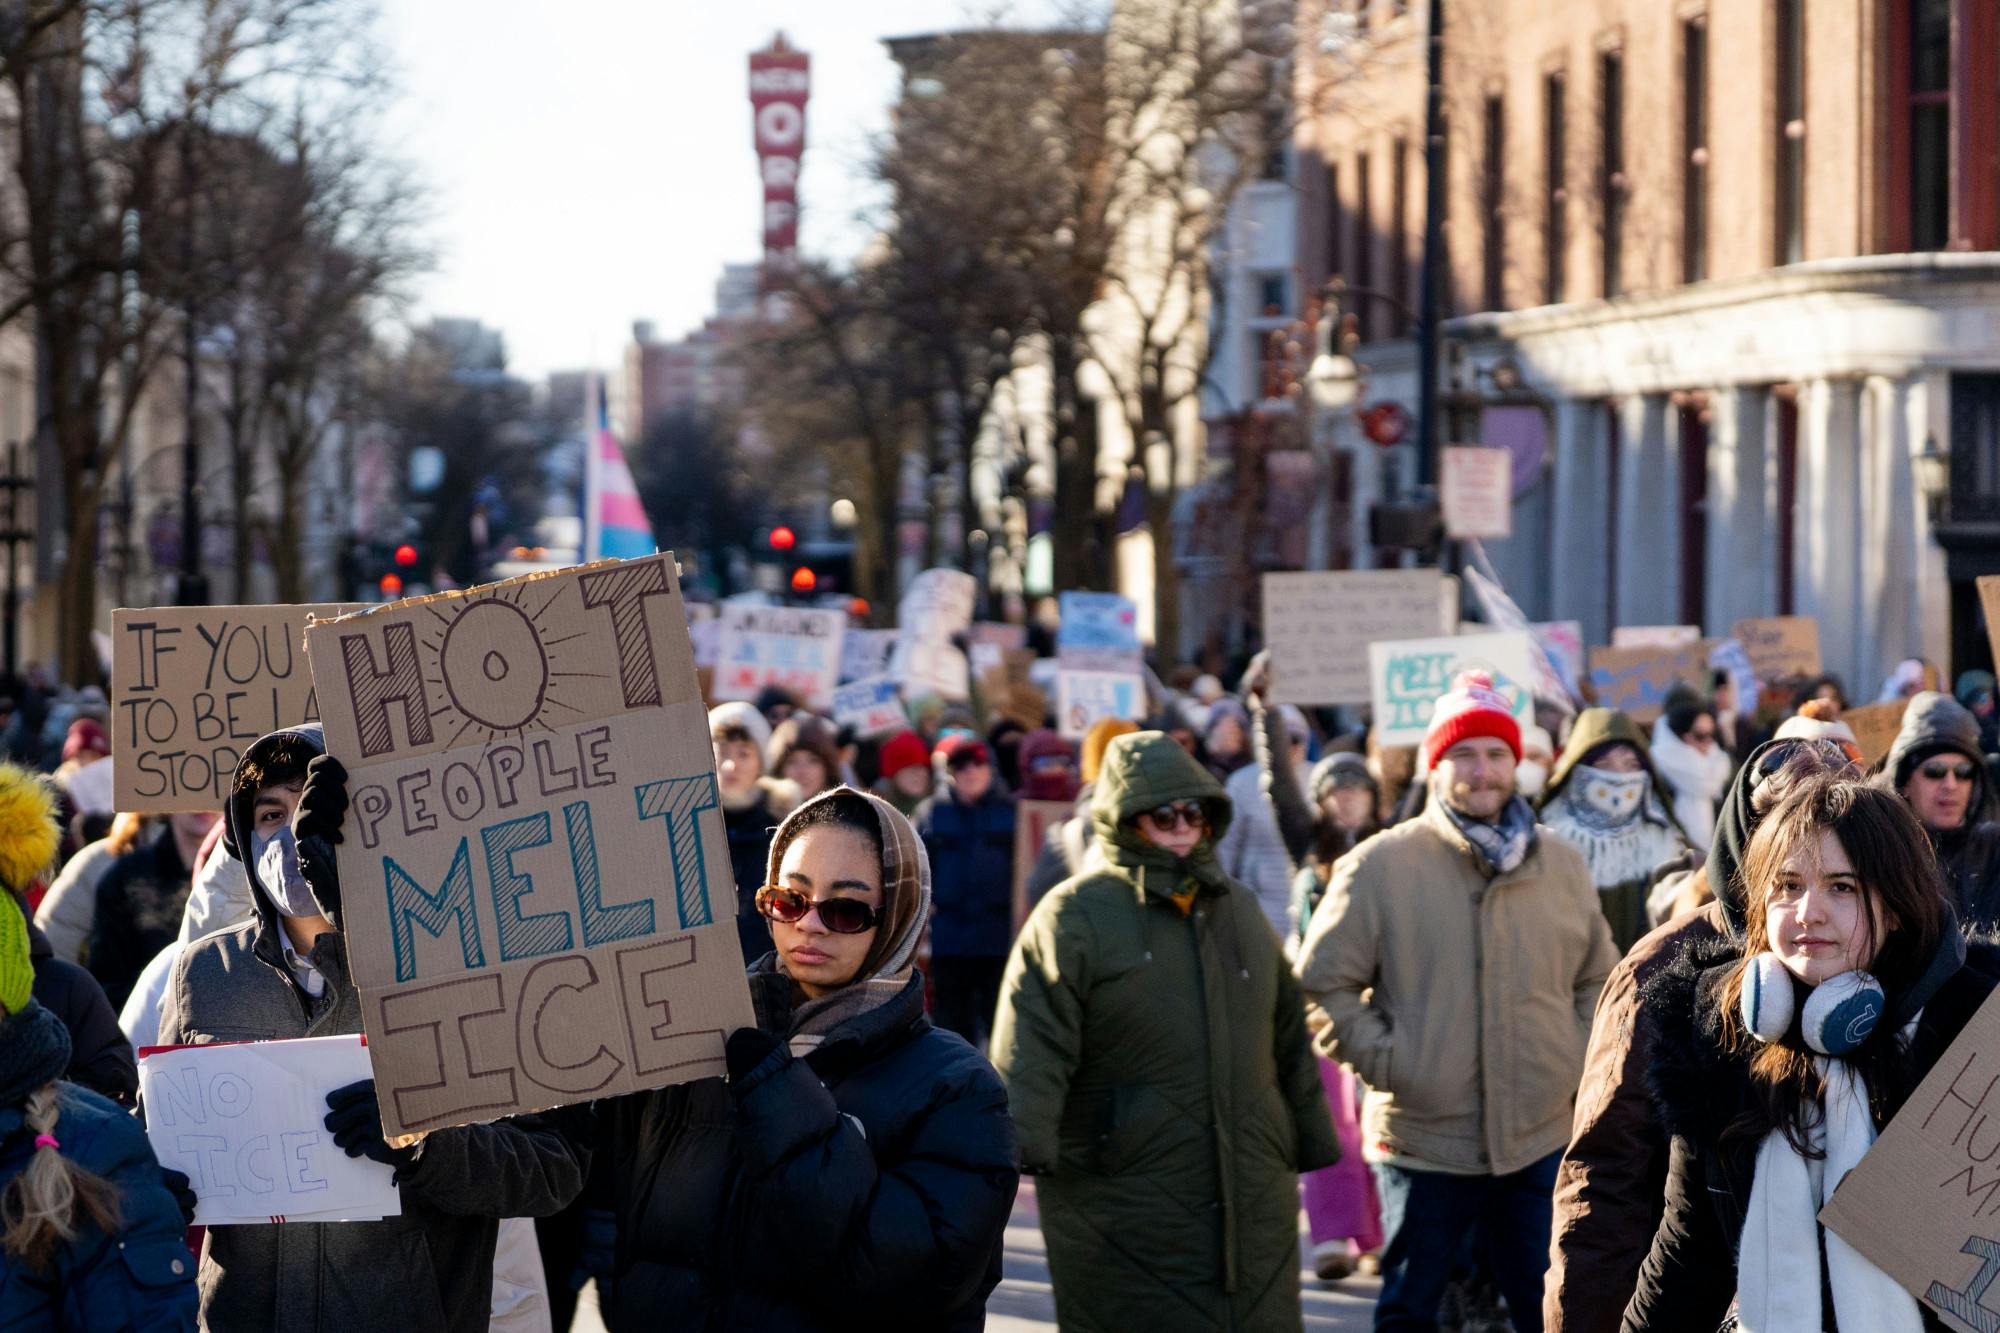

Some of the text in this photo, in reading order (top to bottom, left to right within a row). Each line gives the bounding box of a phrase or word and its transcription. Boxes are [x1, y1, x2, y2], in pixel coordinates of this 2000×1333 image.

[126, 621, 292, 691] IF YOU
[340, 558, 670, 759] HOT
[119, 697, 179, 748] TO
[192, 691, 259, 741] BE
[351, 725, 616, 849] PEOPLE
[382, 772, 719, 983] MELT
[379, 934, 728, 1129] ICE
[152, 1066, 253, 1127] NO
[176, 1130, 328, 1200] ICE
